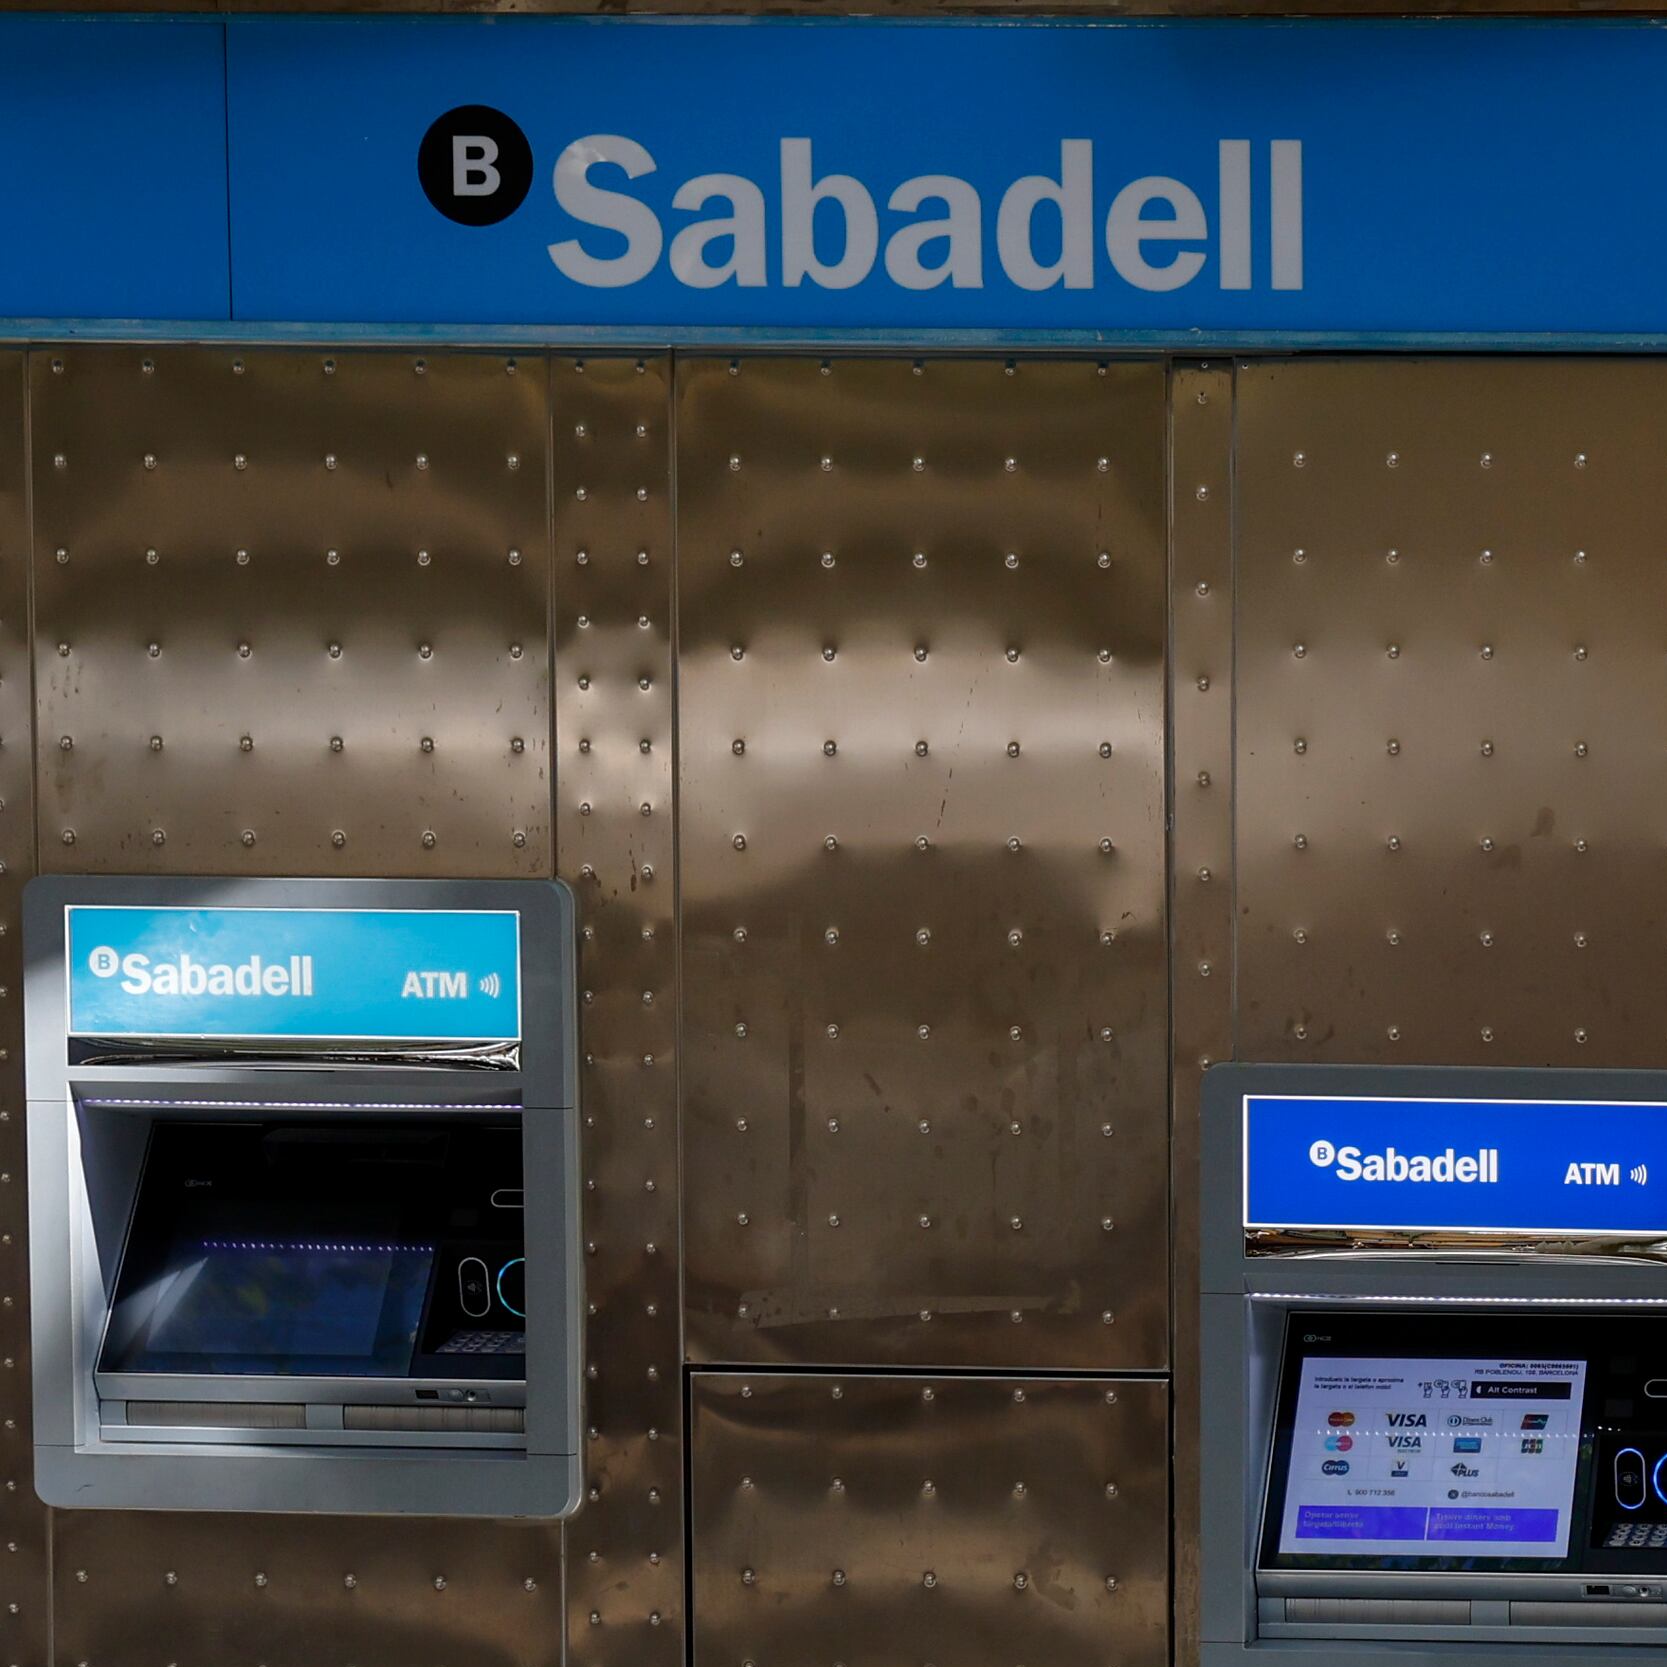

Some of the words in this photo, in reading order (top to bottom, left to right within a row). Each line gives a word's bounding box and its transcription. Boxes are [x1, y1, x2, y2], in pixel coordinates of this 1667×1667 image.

[453, 136, 500, 196] B
[547, 134, 1303, 292] Sabadell
[98, 955, 111, 971] B
[120, 954, 313, 997] Sabadell
[401, 972, 467, 999] ATM
[1317, 1146, 1328, 1161] B
[1336, 1147, 1498, 1183] Sabadell
[1564, 1163, 1619, 1186] ATM
[1386, 1414, 1427, 1428] VISA
[1386, 1436, 1421, 1448] VISA
[1324, 1463, 1348, 1471] Cirrus
